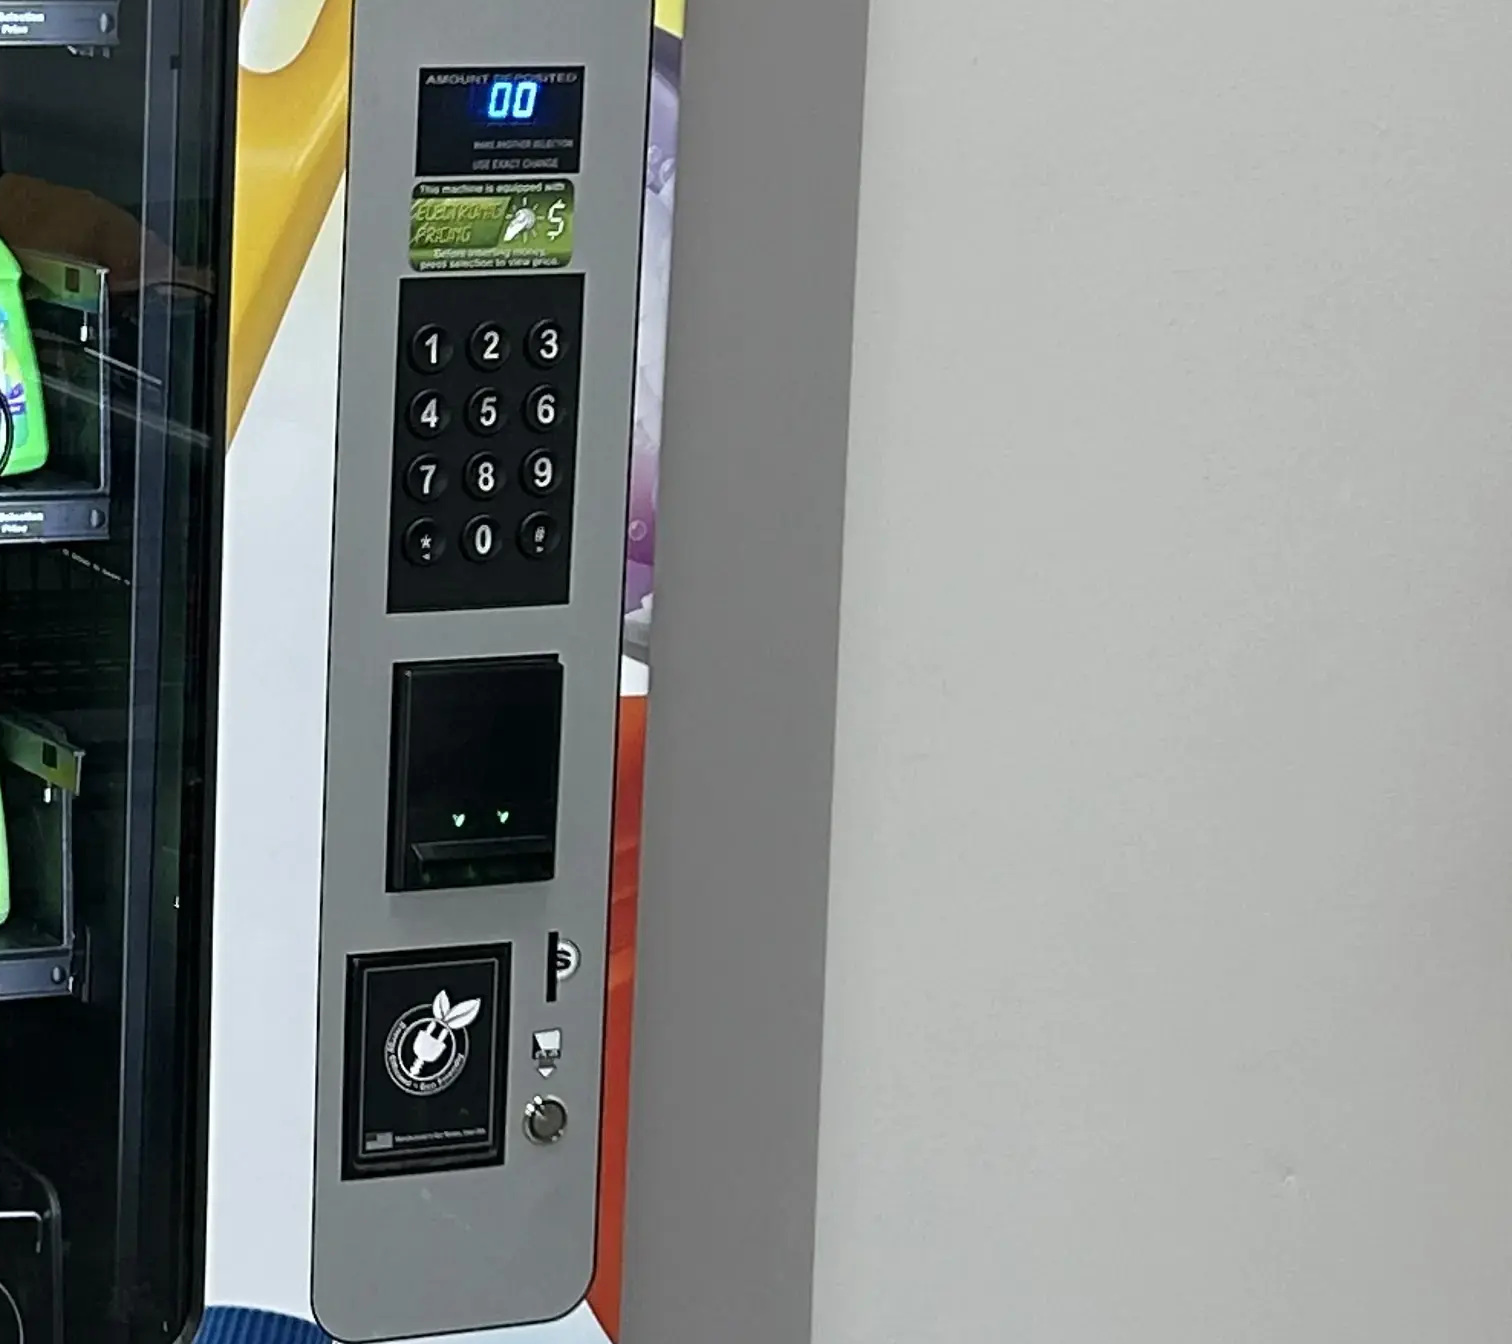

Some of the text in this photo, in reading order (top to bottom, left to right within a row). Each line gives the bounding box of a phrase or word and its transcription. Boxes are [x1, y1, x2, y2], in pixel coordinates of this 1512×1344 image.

[425, 73, 490, 86] AMOUNT
[472, 158, 559, 171] USE EXACT CHANGE
[420, 184, 439, 194] This
[442, 184, 483, 194] machine
[485, 184, 494, 193] is
[496, 182, 543, 194] equipped
[450, 259, 493, 268] selection
[508, 258, 530, 267] view
[424, 328, 559, 364] 1 2 3
[420, 393, 555, 428] 4 5 6
[419, 456, 553, 494] 7 8 9
[475, 524, 492, 555] 0
